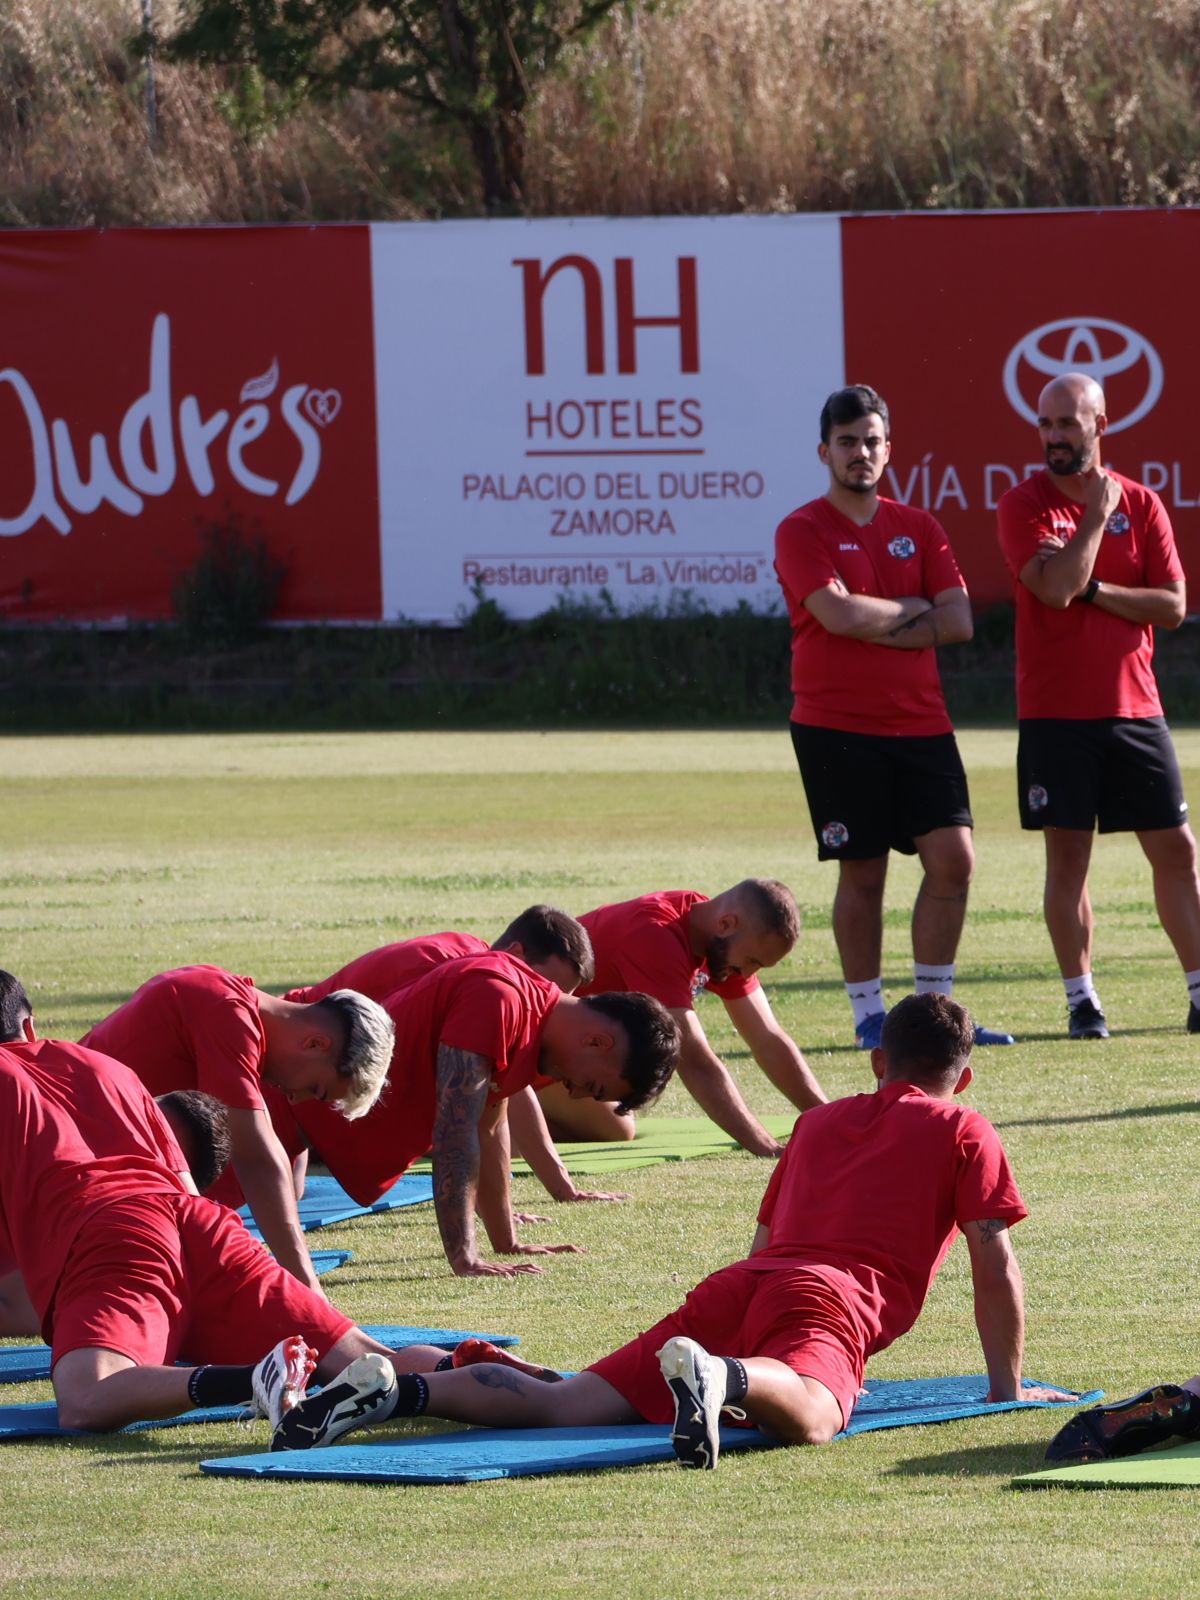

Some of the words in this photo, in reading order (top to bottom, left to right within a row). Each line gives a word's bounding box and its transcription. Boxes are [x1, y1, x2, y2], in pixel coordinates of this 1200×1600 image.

[526, 398, 704, 439] HOTELES
[462, 472, 586, 501] PALACIO
[595, 472, 651, 500] DEL
[659, 470, 765, 499] DUERO
[886, 451, 969, 511] VÍA
[549, 508, 676, 537] ZAMORA
[462, 560, 608, 586] Restaurante
